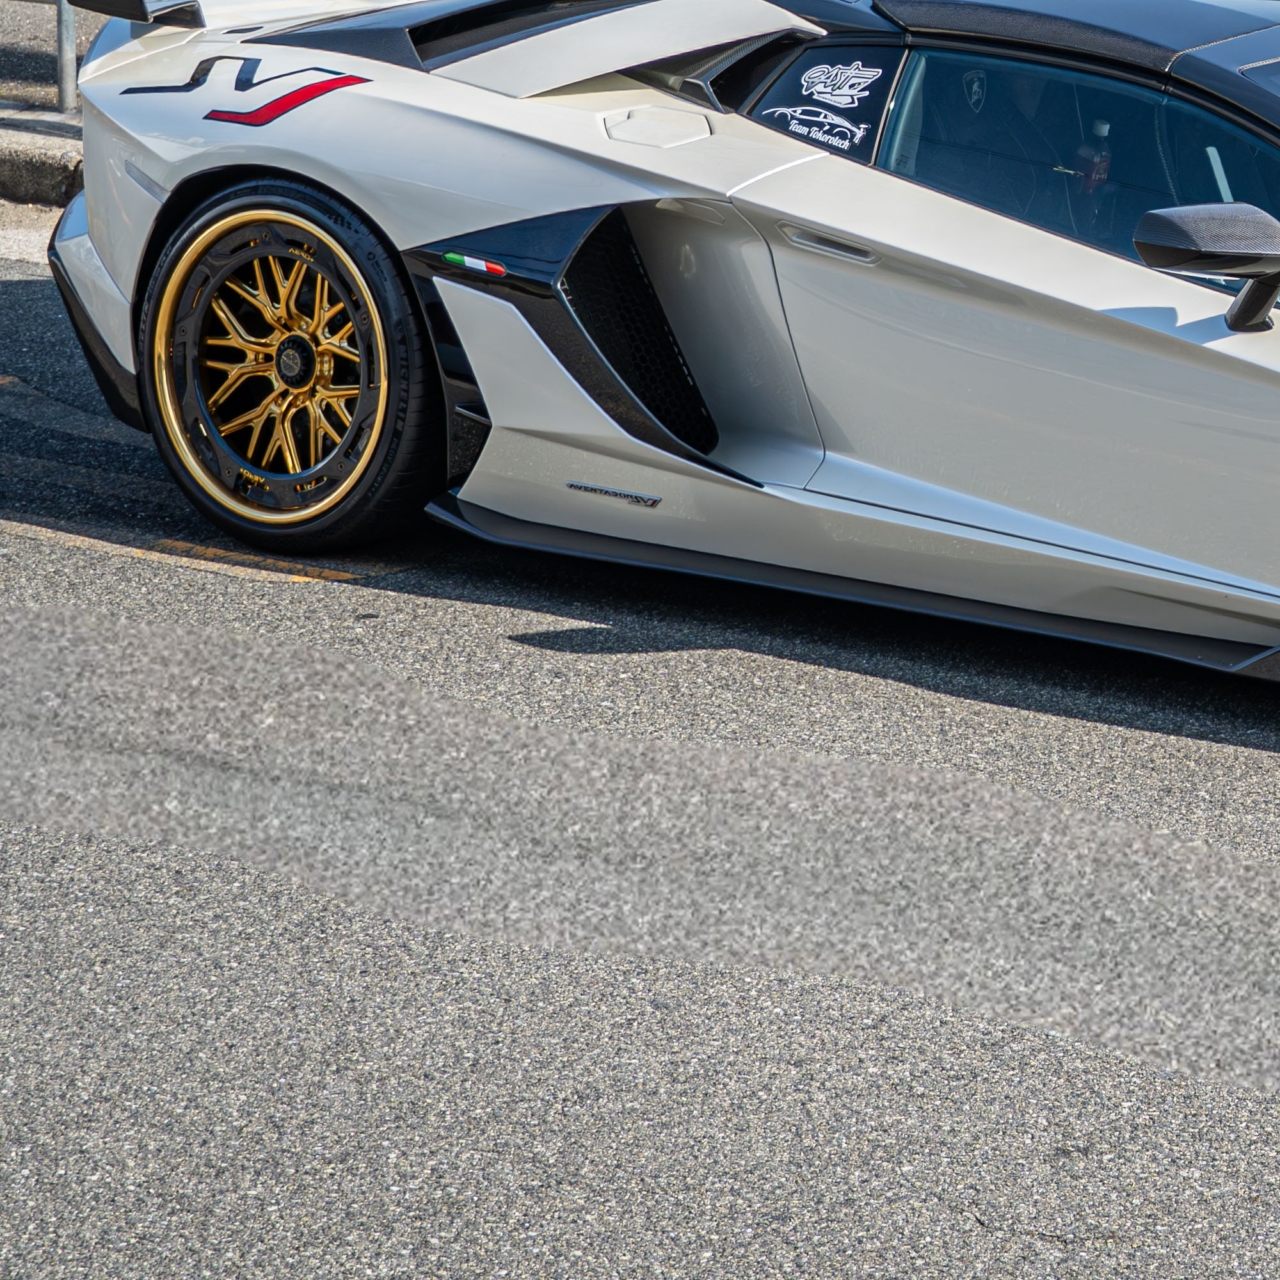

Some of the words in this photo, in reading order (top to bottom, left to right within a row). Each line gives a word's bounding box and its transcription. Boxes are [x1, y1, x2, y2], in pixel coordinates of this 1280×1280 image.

[789, 120, 810, 136] Team
[809, 127, 850, 151] Tokorotech
[396, 344, 409, 432] MICHELIN
